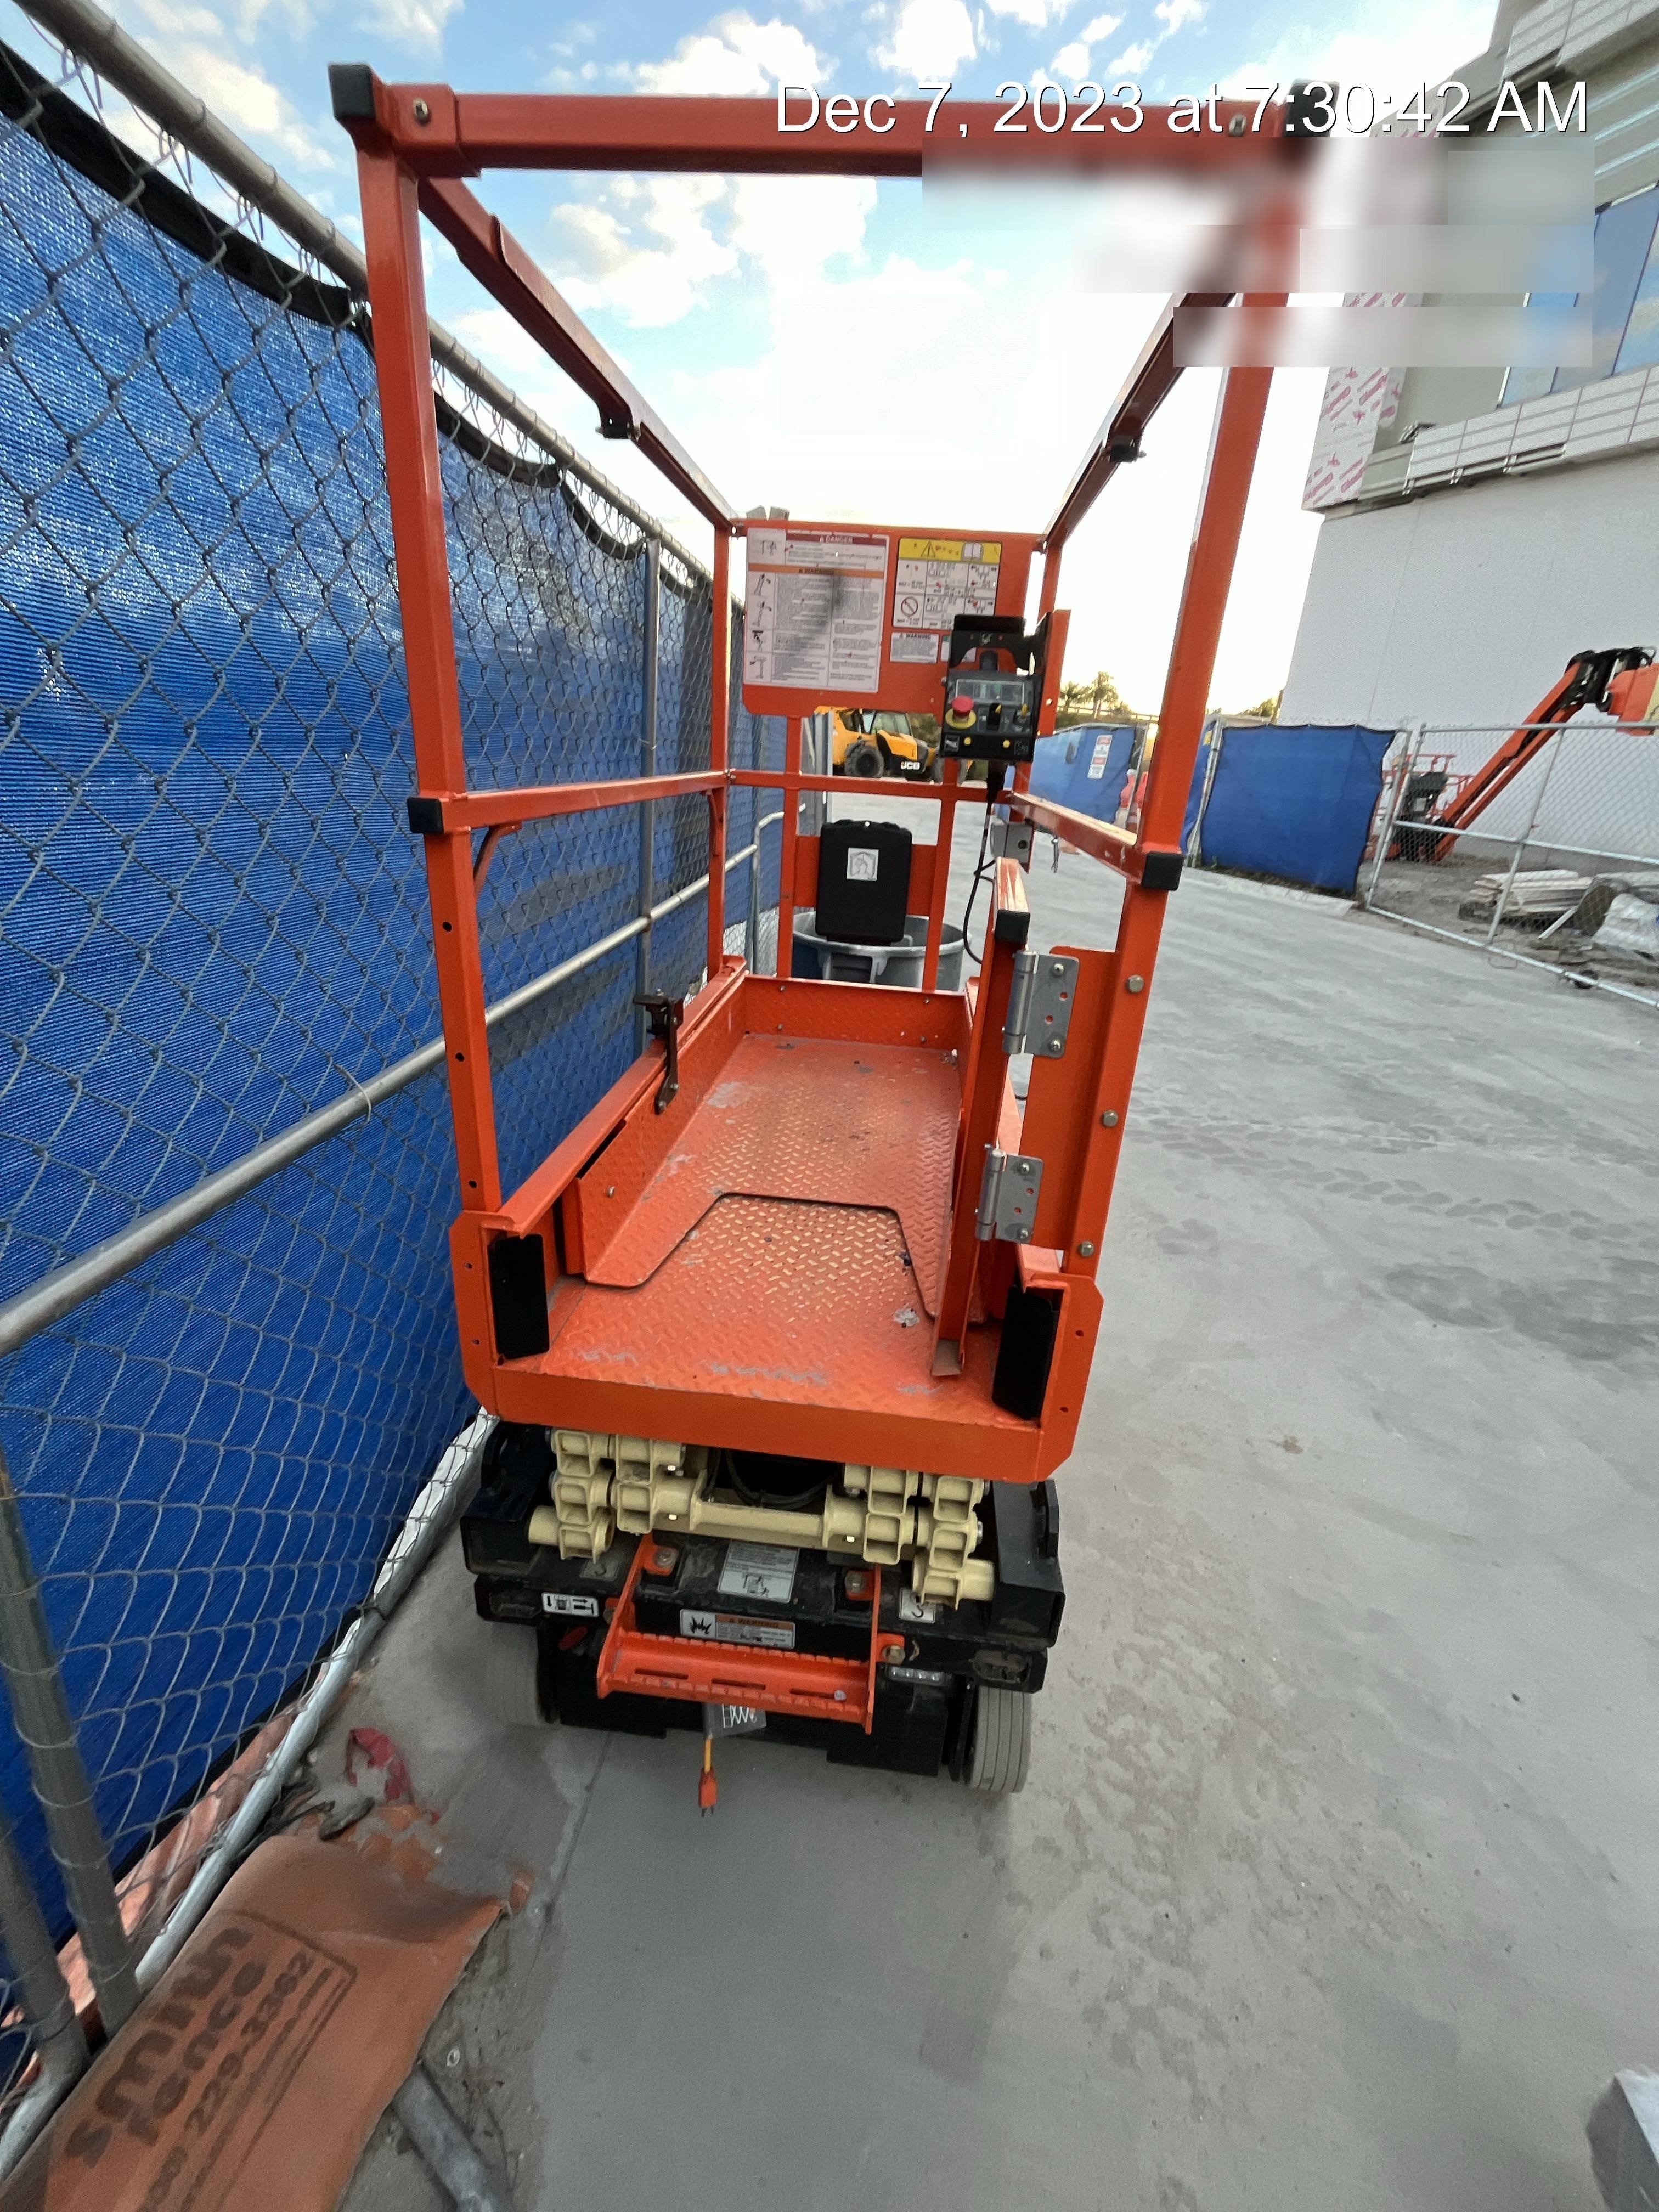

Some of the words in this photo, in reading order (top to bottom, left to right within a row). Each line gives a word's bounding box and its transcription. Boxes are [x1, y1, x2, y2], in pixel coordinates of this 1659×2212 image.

[825, 535, 854, 544] DANGER
[900, 761, 920, 770] JCB
[737, 1618, 779, 1628] WARNING
[64, 1928, 253, 2169] smith
[127, 1961, 267, 2146] fence
